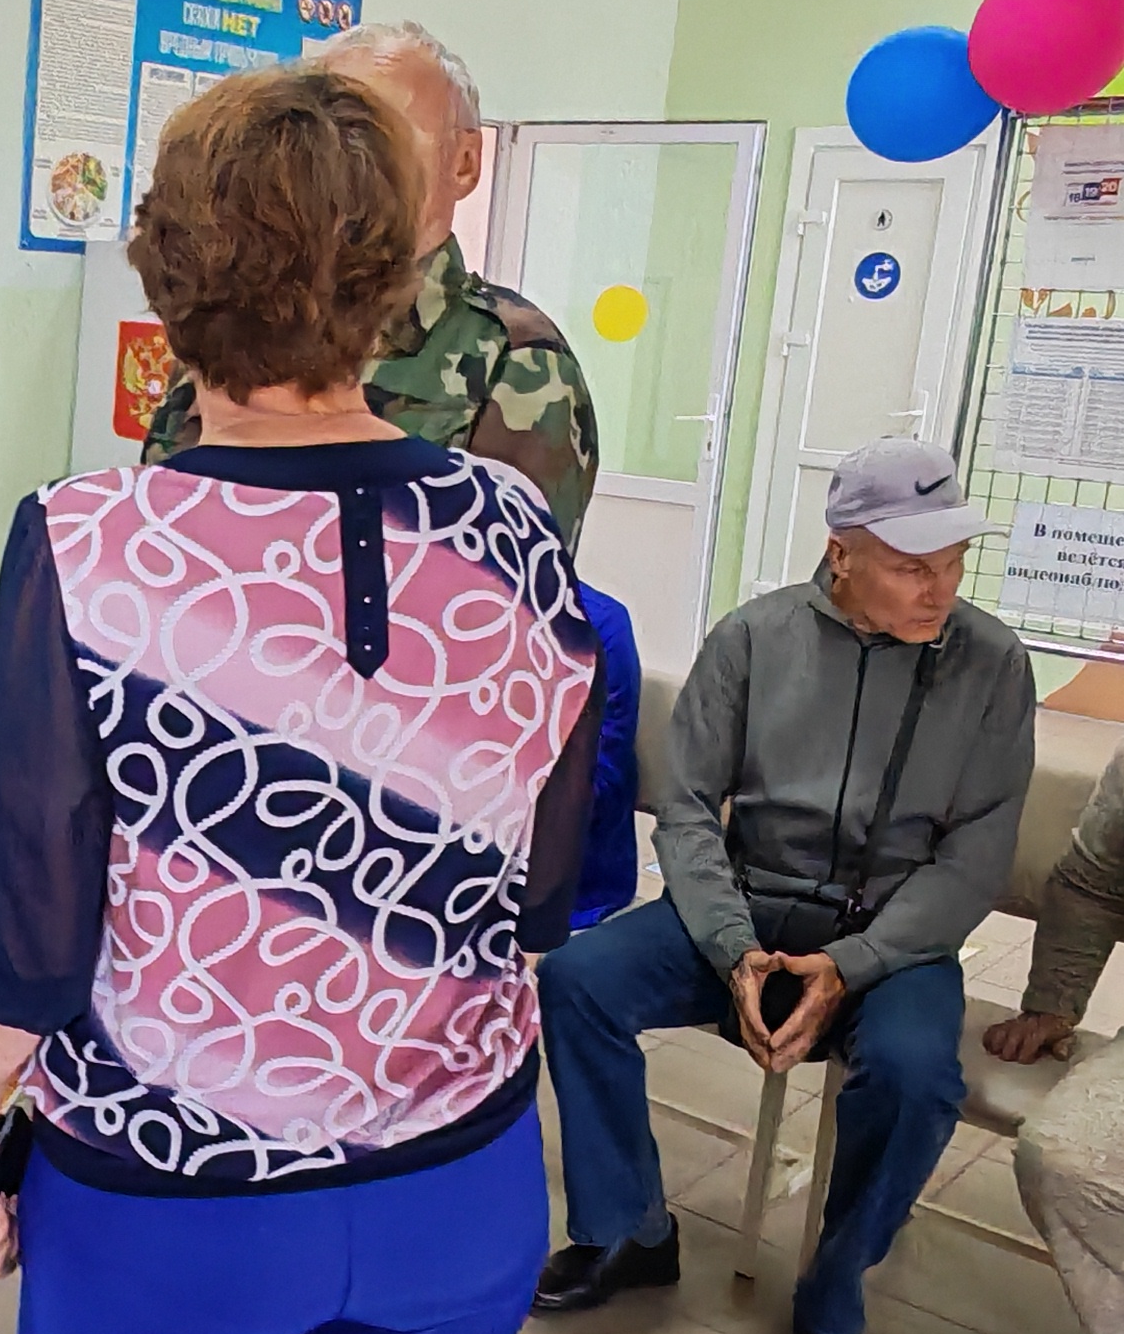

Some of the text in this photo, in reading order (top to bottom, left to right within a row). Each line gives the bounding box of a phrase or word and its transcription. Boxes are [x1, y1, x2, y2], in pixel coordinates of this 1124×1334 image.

[222, 9, 261, 38] НЕТ
[1101, 181, 1117, 192] 20
[1034, 523, 1046, 537] В
[1007, 566, 1124, 591] видеонаблю
